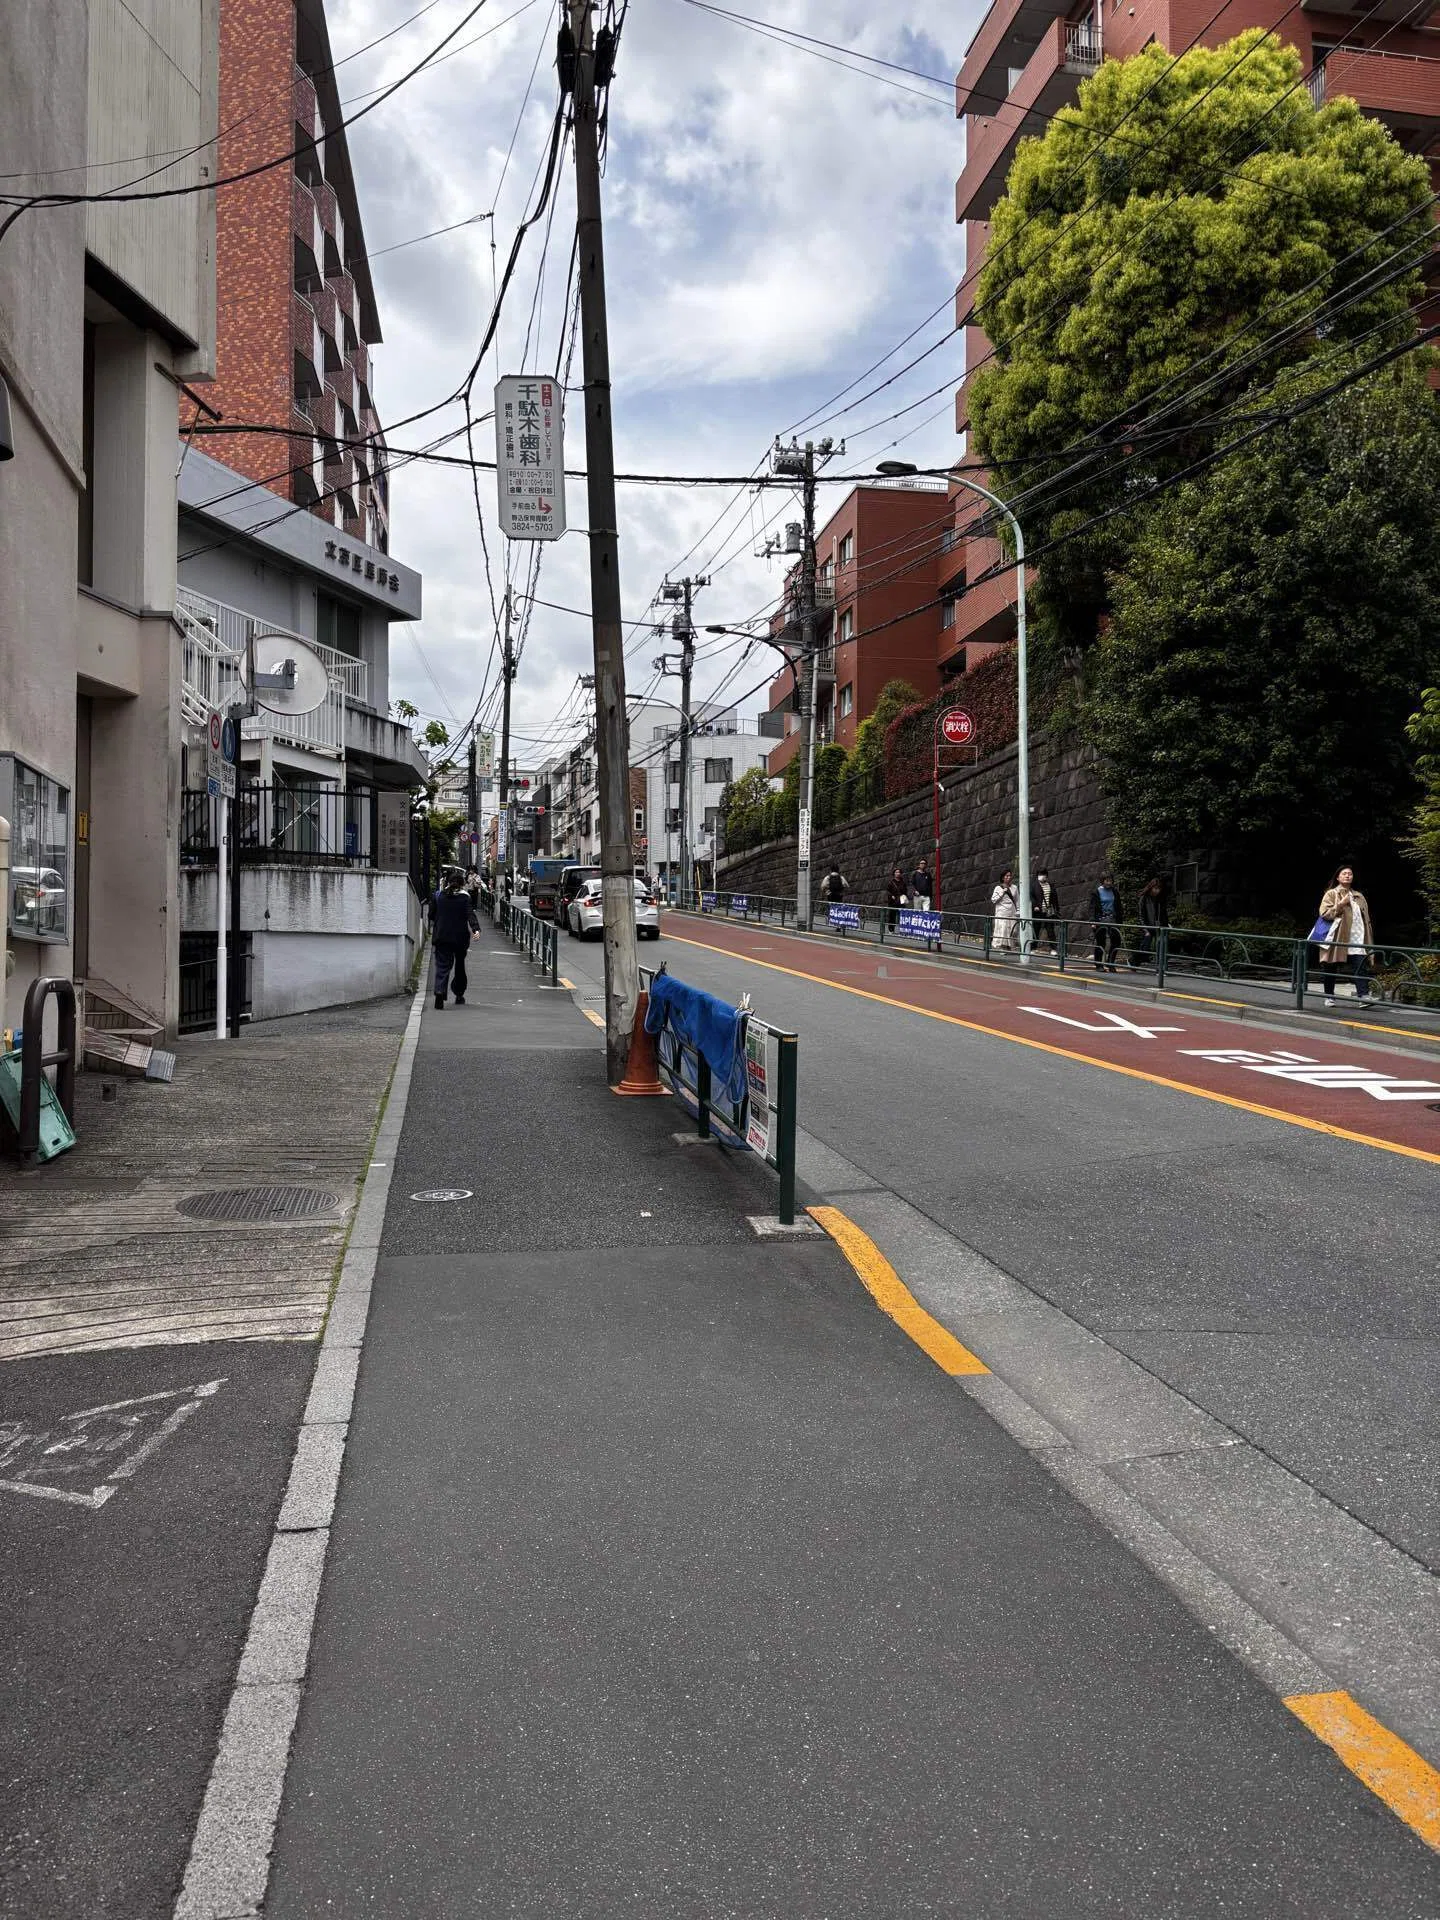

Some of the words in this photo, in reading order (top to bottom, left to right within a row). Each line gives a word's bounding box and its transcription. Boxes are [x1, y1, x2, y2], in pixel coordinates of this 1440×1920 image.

[518, 384, 541, 467] 千駄木歯科
[511, 522, 553, 531] 3824-5703
[945, 721, 969, 733] 消火栓
